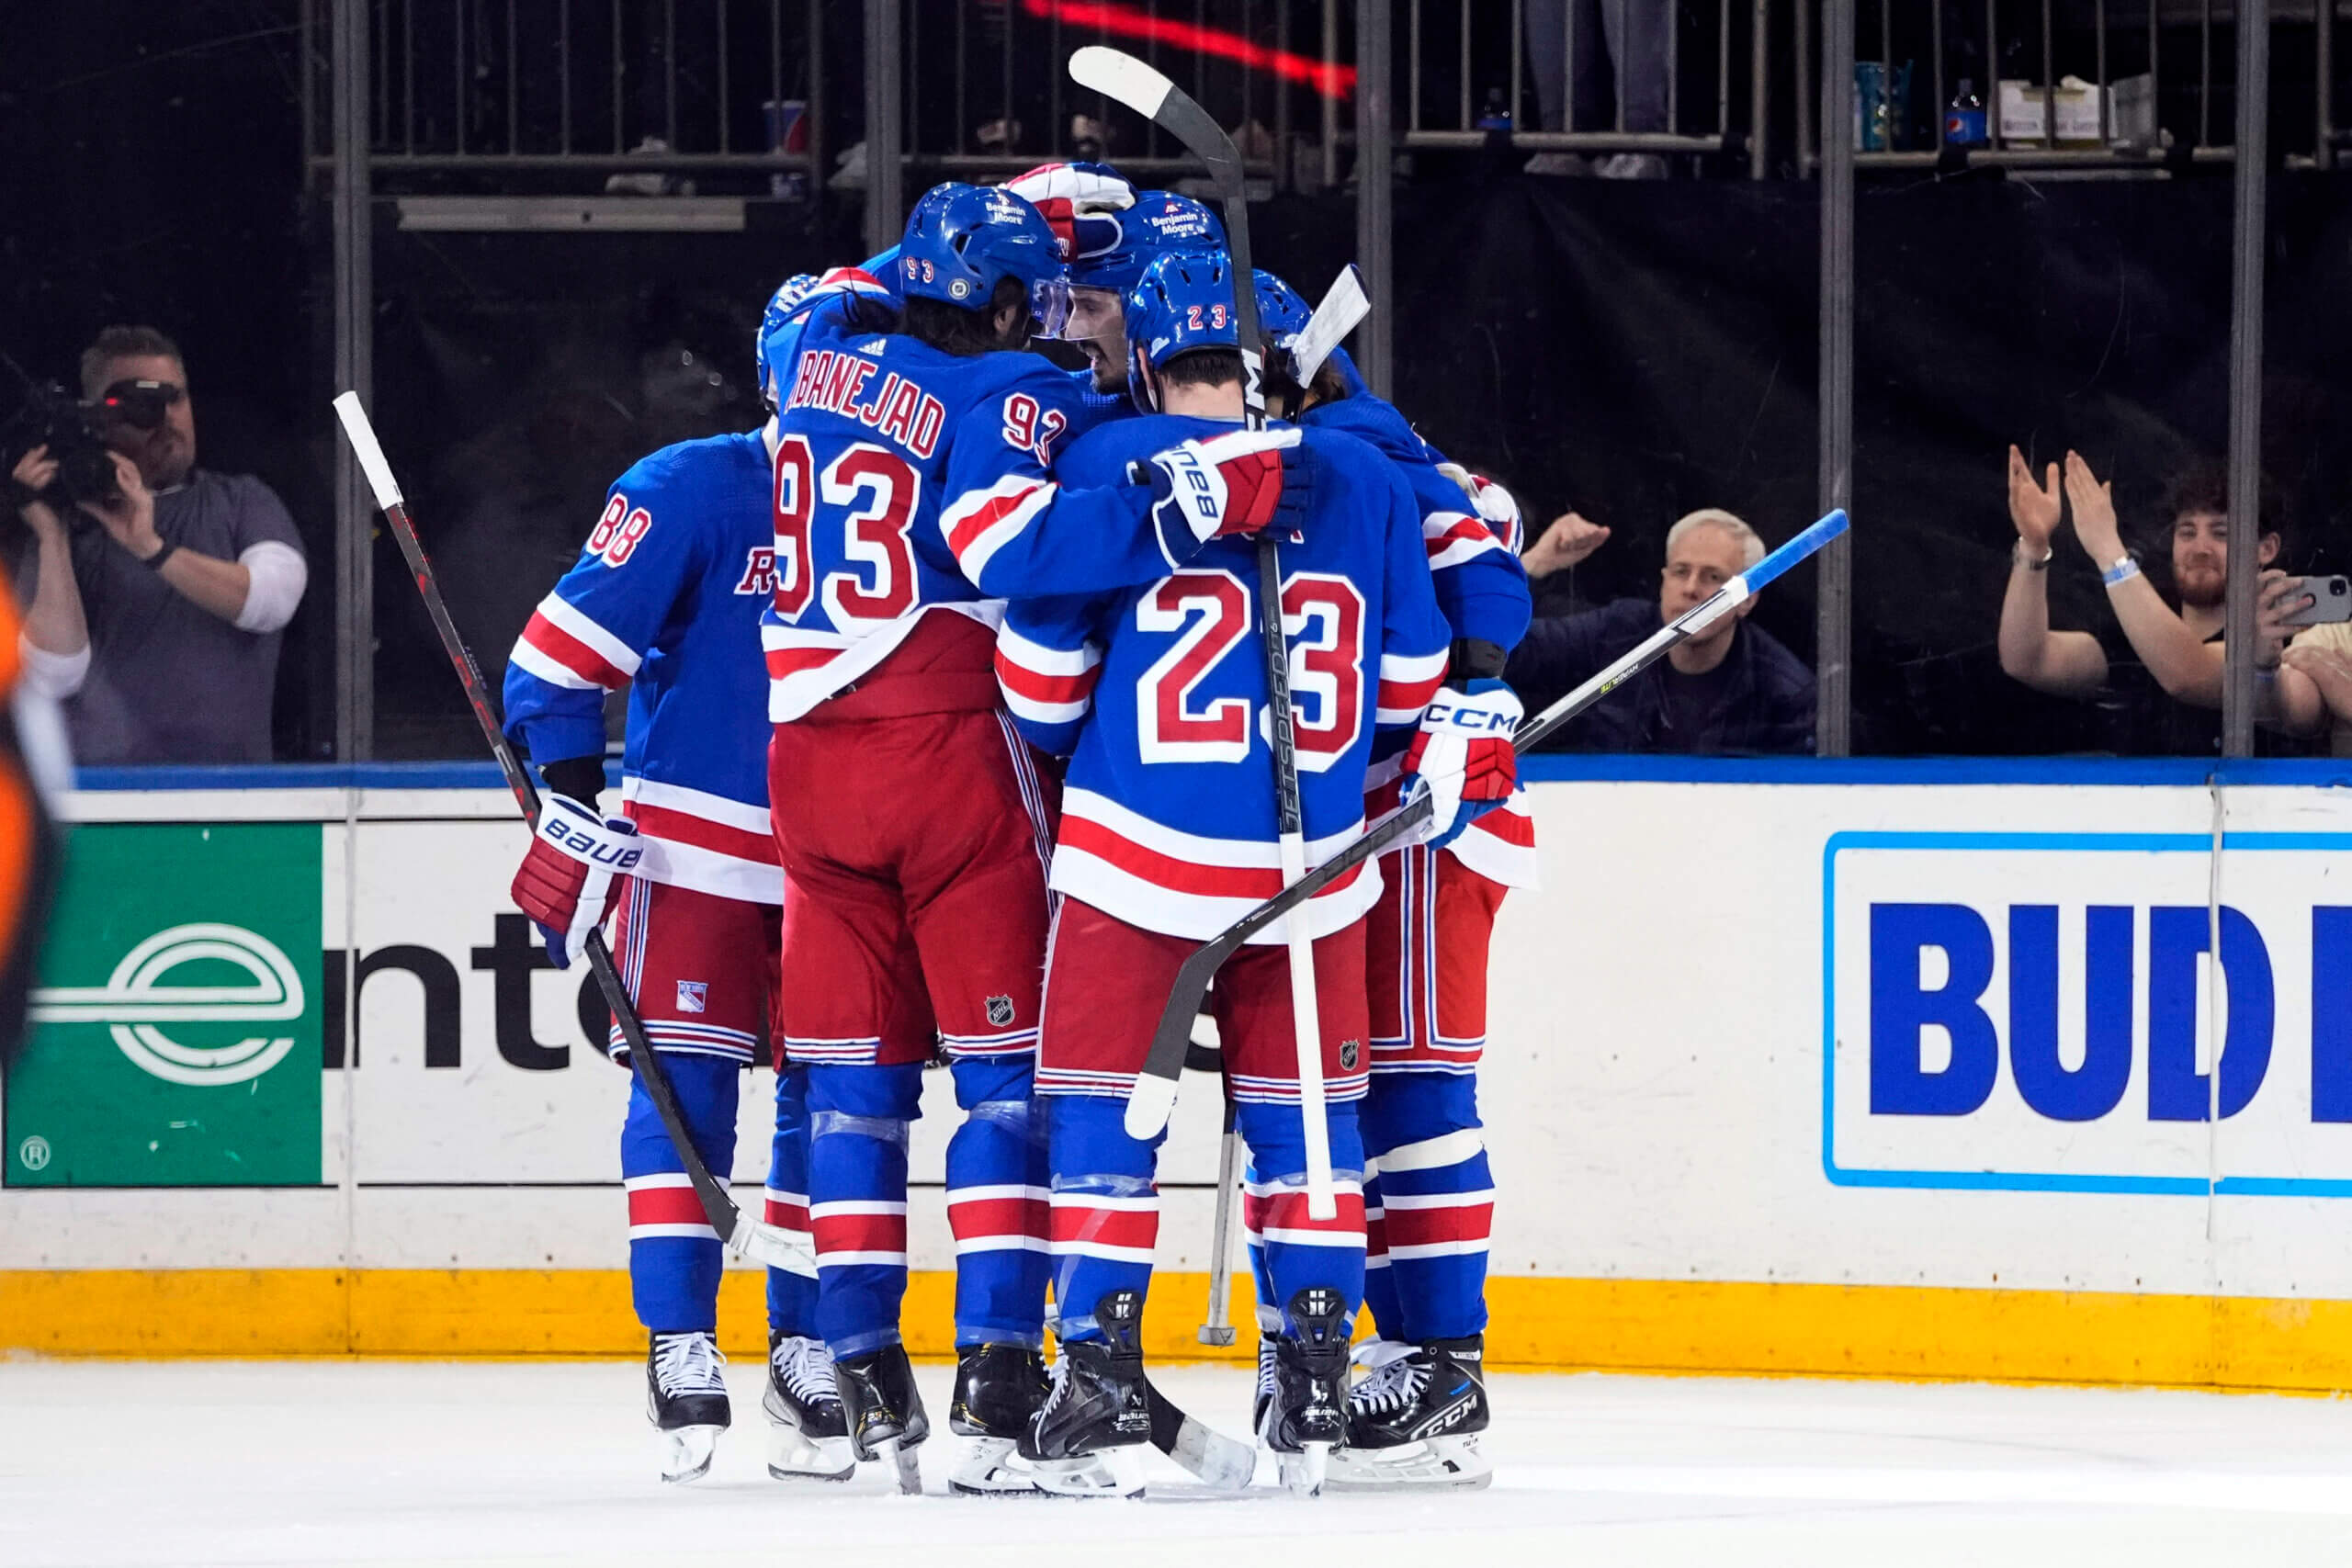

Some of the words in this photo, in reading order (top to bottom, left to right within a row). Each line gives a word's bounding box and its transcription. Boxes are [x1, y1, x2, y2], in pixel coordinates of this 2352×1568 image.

[985, 201, 1026, 217] Benjamin
[994, 213, 1023, 225] Moore
[1151, 212, 1198, 227] Benjamin
[1161, 223, 1194, 236] Moore
[906, 256, 934, 284] 93
[1187, 305, 1226, 331] 23
[586, 492, 652, 569] 88
[774, 434, 922, 636] 93
[1136, 568, 1366, 773] 23
[1425, 704, 1518, 733] CCM
[1272, 653, 1302, 833] JETSPEED
[1870, 902, 2276, 1123] BUD
[1426, 1394, 1477, 1438] CCM
